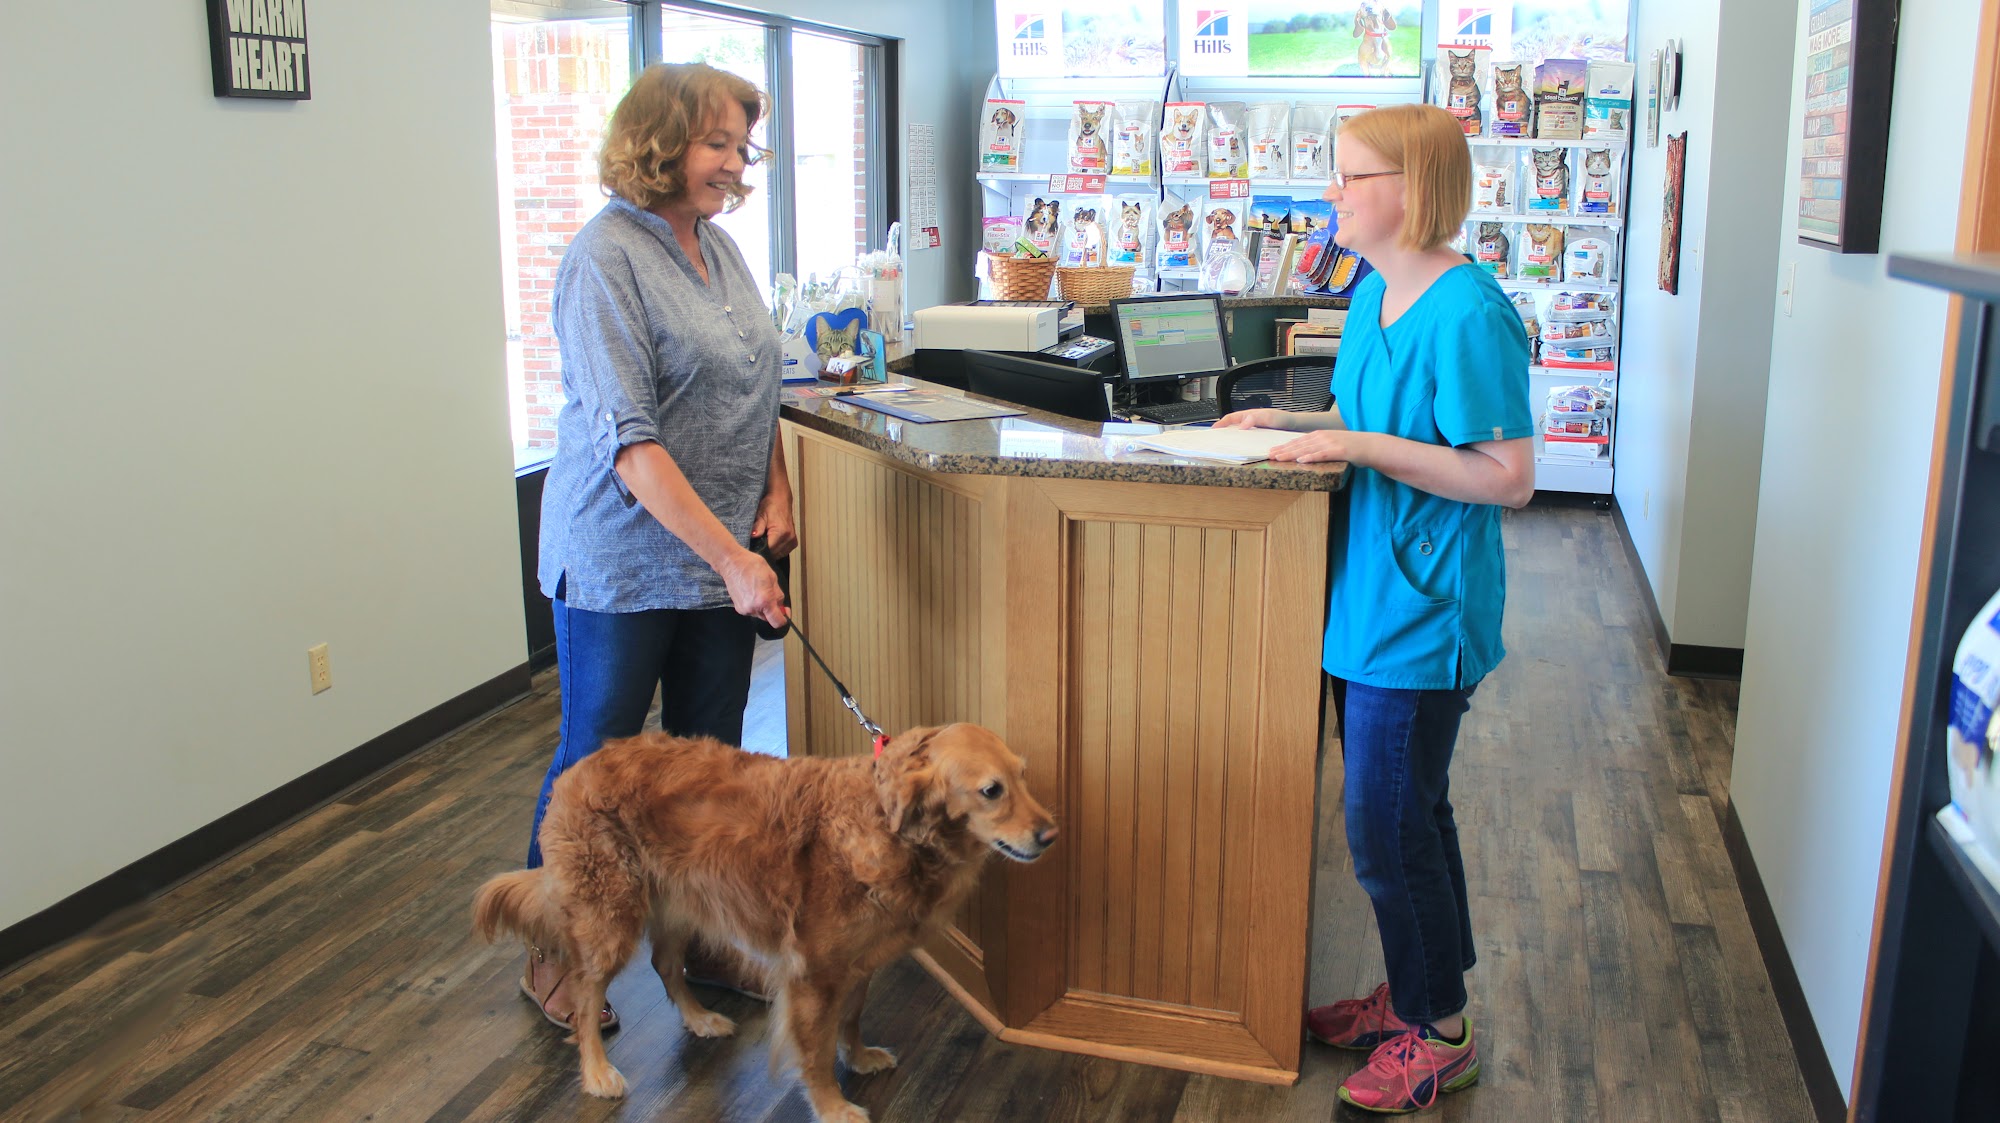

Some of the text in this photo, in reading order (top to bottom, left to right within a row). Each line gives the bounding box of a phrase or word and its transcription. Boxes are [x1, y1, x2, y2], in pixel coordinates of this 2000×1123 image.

[226, 0, 305, 39] WARM
[1012, 42, 1048, 56] Hill's
[1193, 39, 1232, 54] Hill's
[1810, 26, 1841, 53] WAG MORE
[229, 37, 306, 92] HEART
[782, 367, 796, 375] EATS
